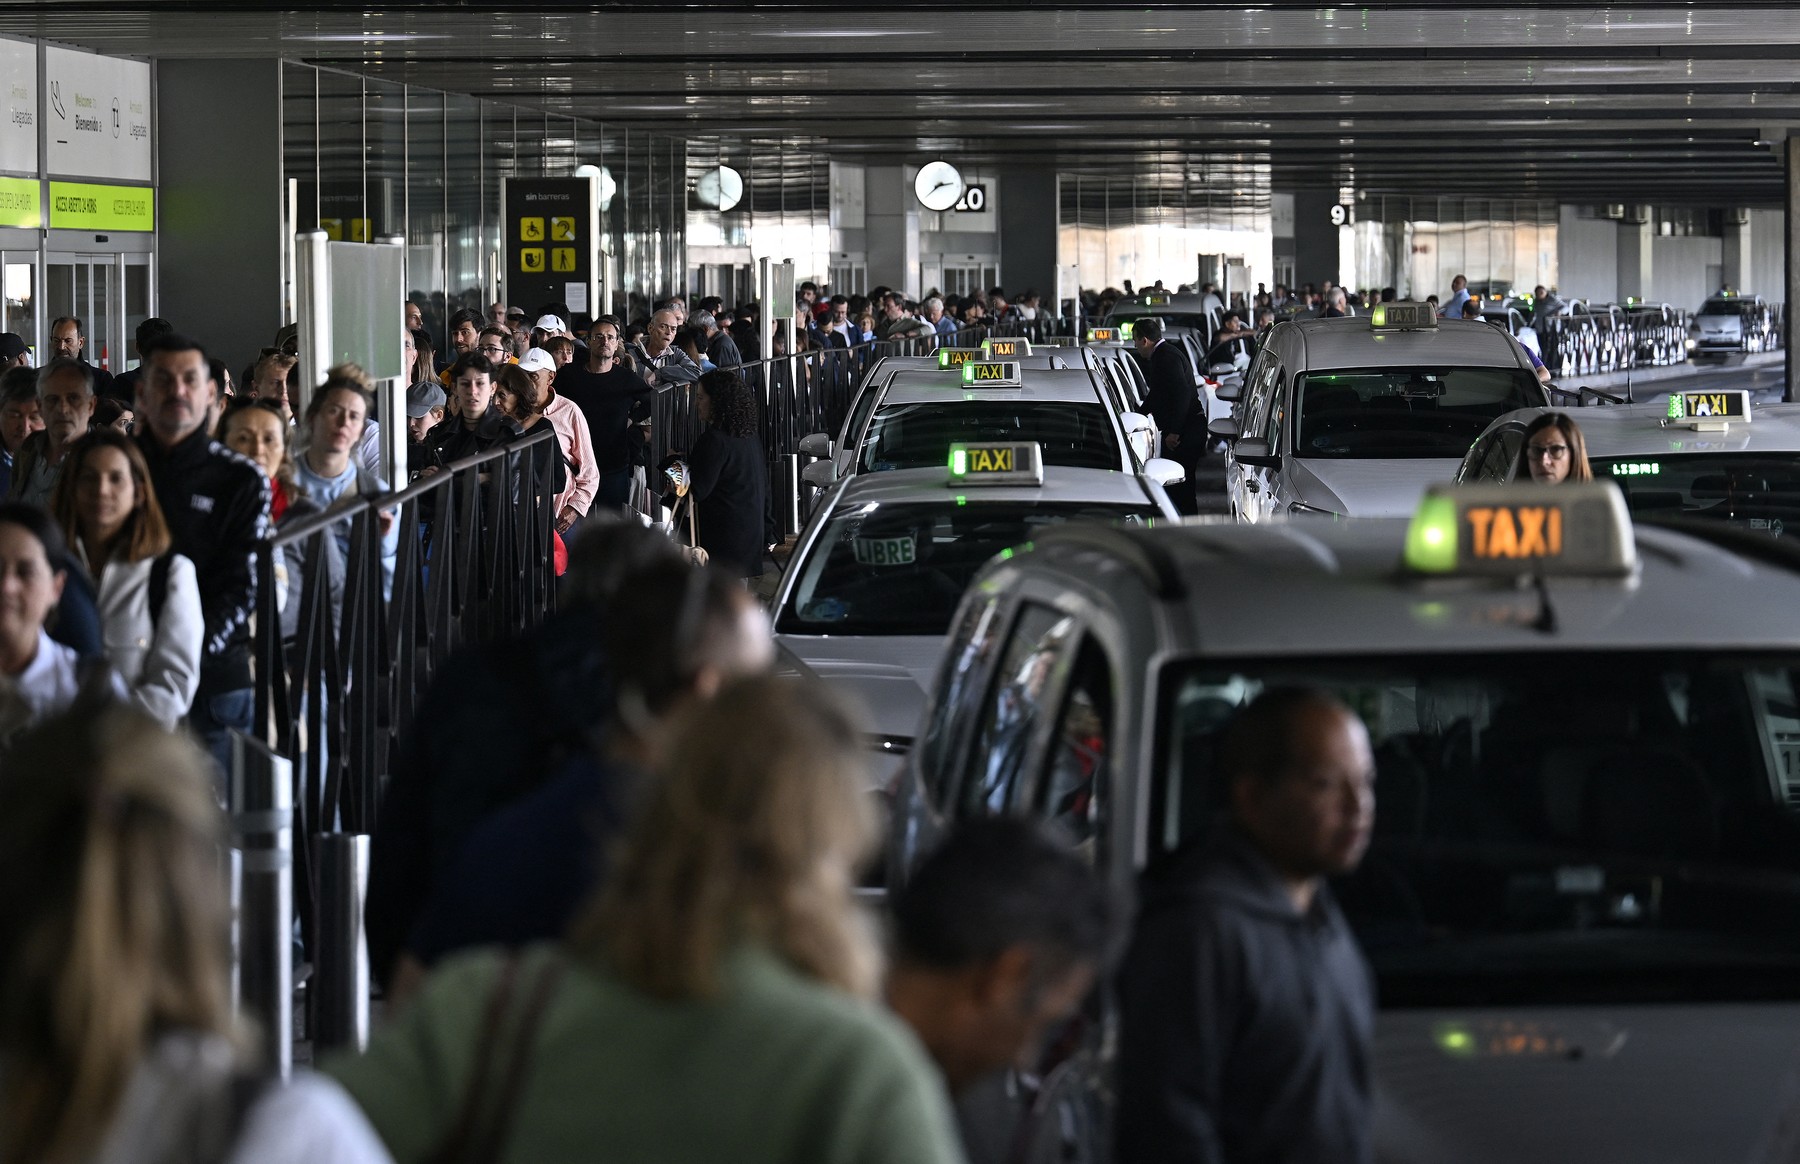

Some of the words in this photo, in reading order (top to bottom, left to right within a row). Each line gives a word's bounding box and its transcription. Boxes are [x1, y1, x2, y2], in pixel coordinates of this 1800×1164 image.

[12, 107, 32, 128] Llegadas
[76, 114, 98, 132] Bienvenido
[112, 108, 120, 128] T1
[130, 121, 146, 140] Llegadas
[526, 192, 537, 200] sin
[1331, 205, 1345, 225] 9
[1390, 308, 1416, 322] TAXI
[950, 352, 973, 364] TAXI
[992, 343, 1014, 355] TAXI
[974, 364, 1003, 379] TAXI
[1687, 394, 1728, 416] TAXI
[968, 449, 1013, 471] TAXI
[1467, 507, 1562, 558] TAXI
[857, 539, 914, 563] LIBRE
